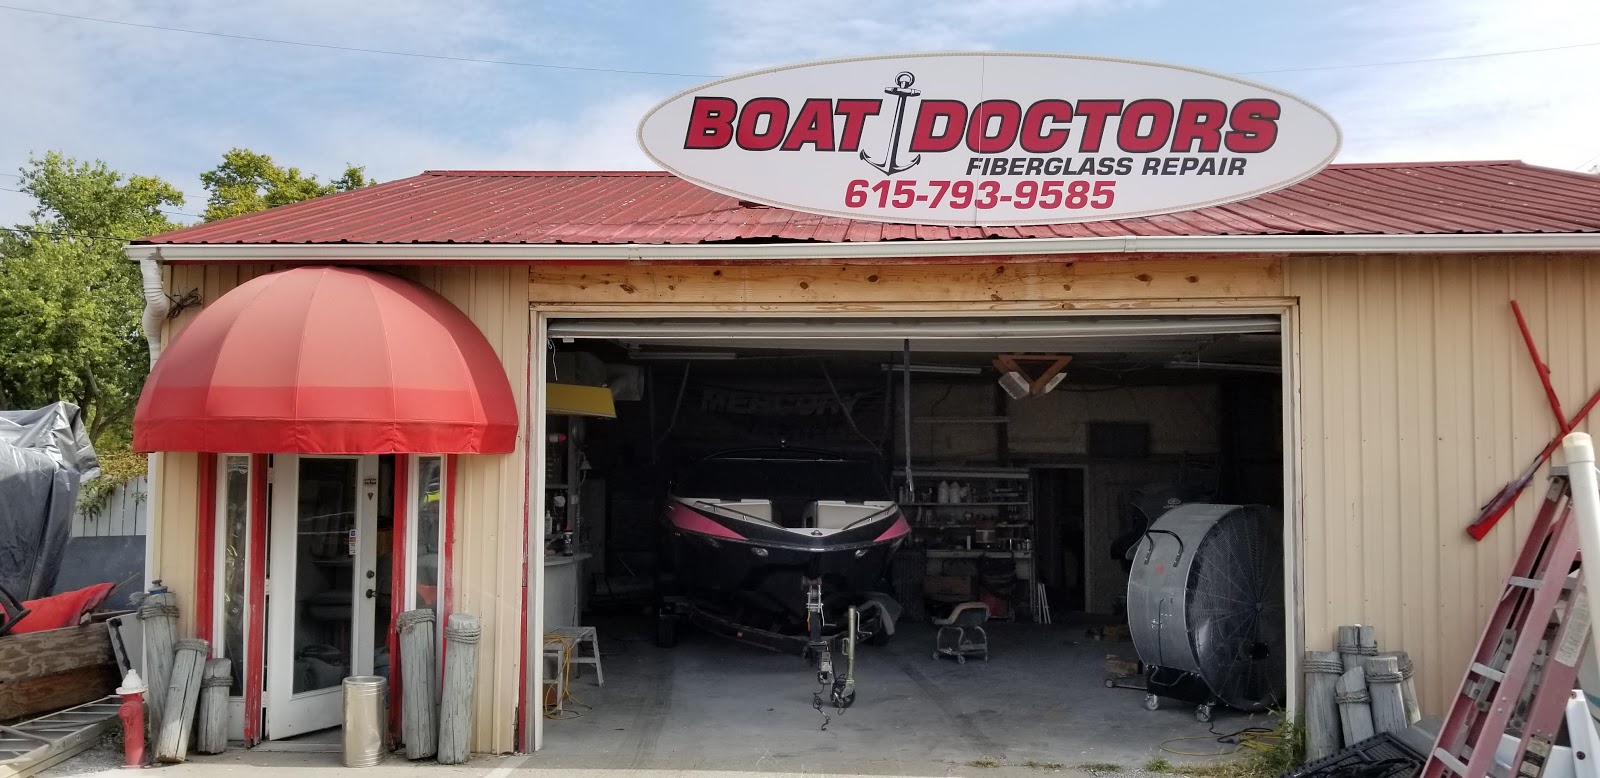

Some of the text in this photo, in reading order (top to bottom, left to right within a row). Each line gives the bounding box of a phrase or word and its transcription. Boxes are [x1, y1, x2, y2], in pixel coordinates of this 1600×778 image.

[684, 96, 1281, 154] BOAT DOCTORS
[966, 157, 1247, 176] FIBERGLASS REPAIR
[844, 180, 1116, 210] 615-793-9585
